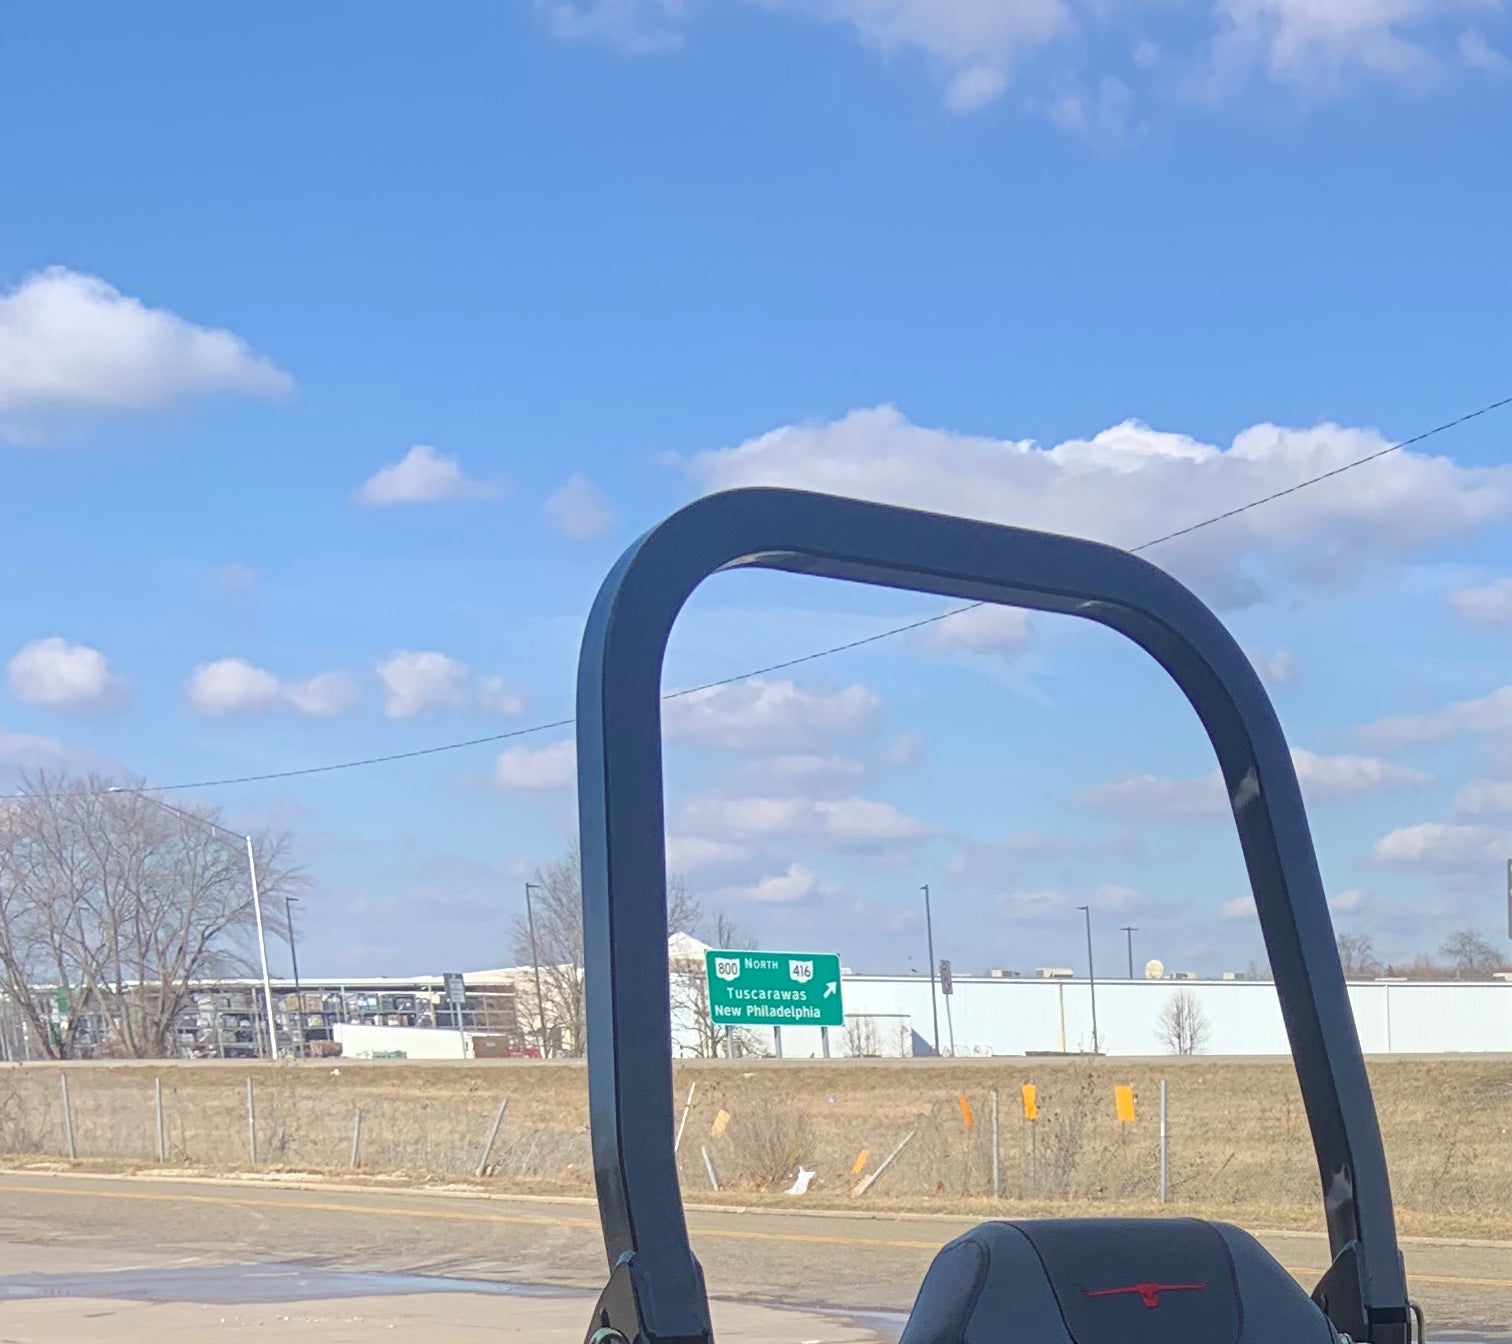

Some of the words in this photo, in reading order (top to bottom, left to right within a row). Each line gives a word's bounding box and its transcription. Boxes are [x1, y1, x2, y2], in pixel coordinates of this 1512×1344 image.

[718, 962, 738, 976] 800
[792, 964, 811, 978] 416
[727, 987, 807, 1001] Tuscarawas
[714, 1005, 741, 1017] New
[746, 1005, 821, 1020] Philadelphia
